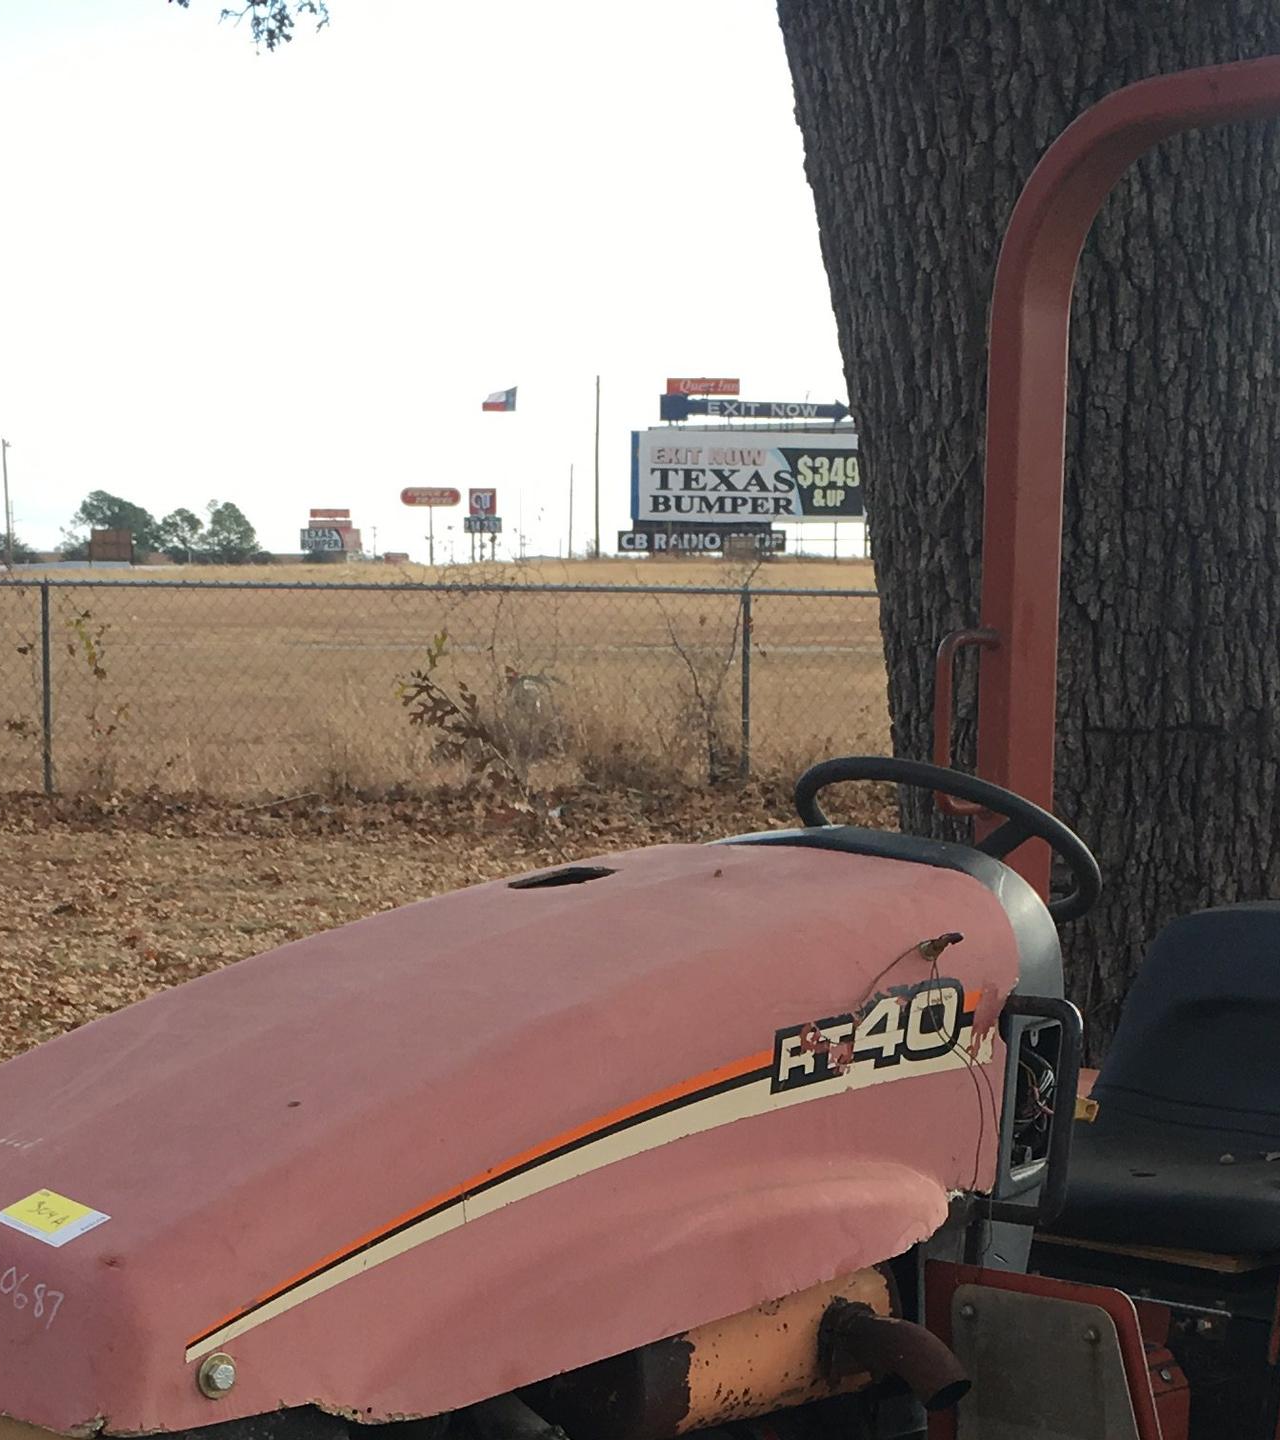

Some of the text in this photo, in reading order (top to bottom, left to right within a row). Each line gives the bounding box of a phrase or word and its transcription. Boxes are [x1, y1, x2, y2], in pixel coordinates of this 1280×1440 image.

[707, 401, 819, 417] EXIT NOW
[650, 447, 767, 466] EXIT NOW
[650, 468, 796, 493] TEXAS
[797, 455, 860, 489] $349
[649, 494, 797, 515] BUMPER
[621, 533, 648, 550] CB
[654, 533, 721, 549] RADIO
[775, 985, 960, 1083] RT40
